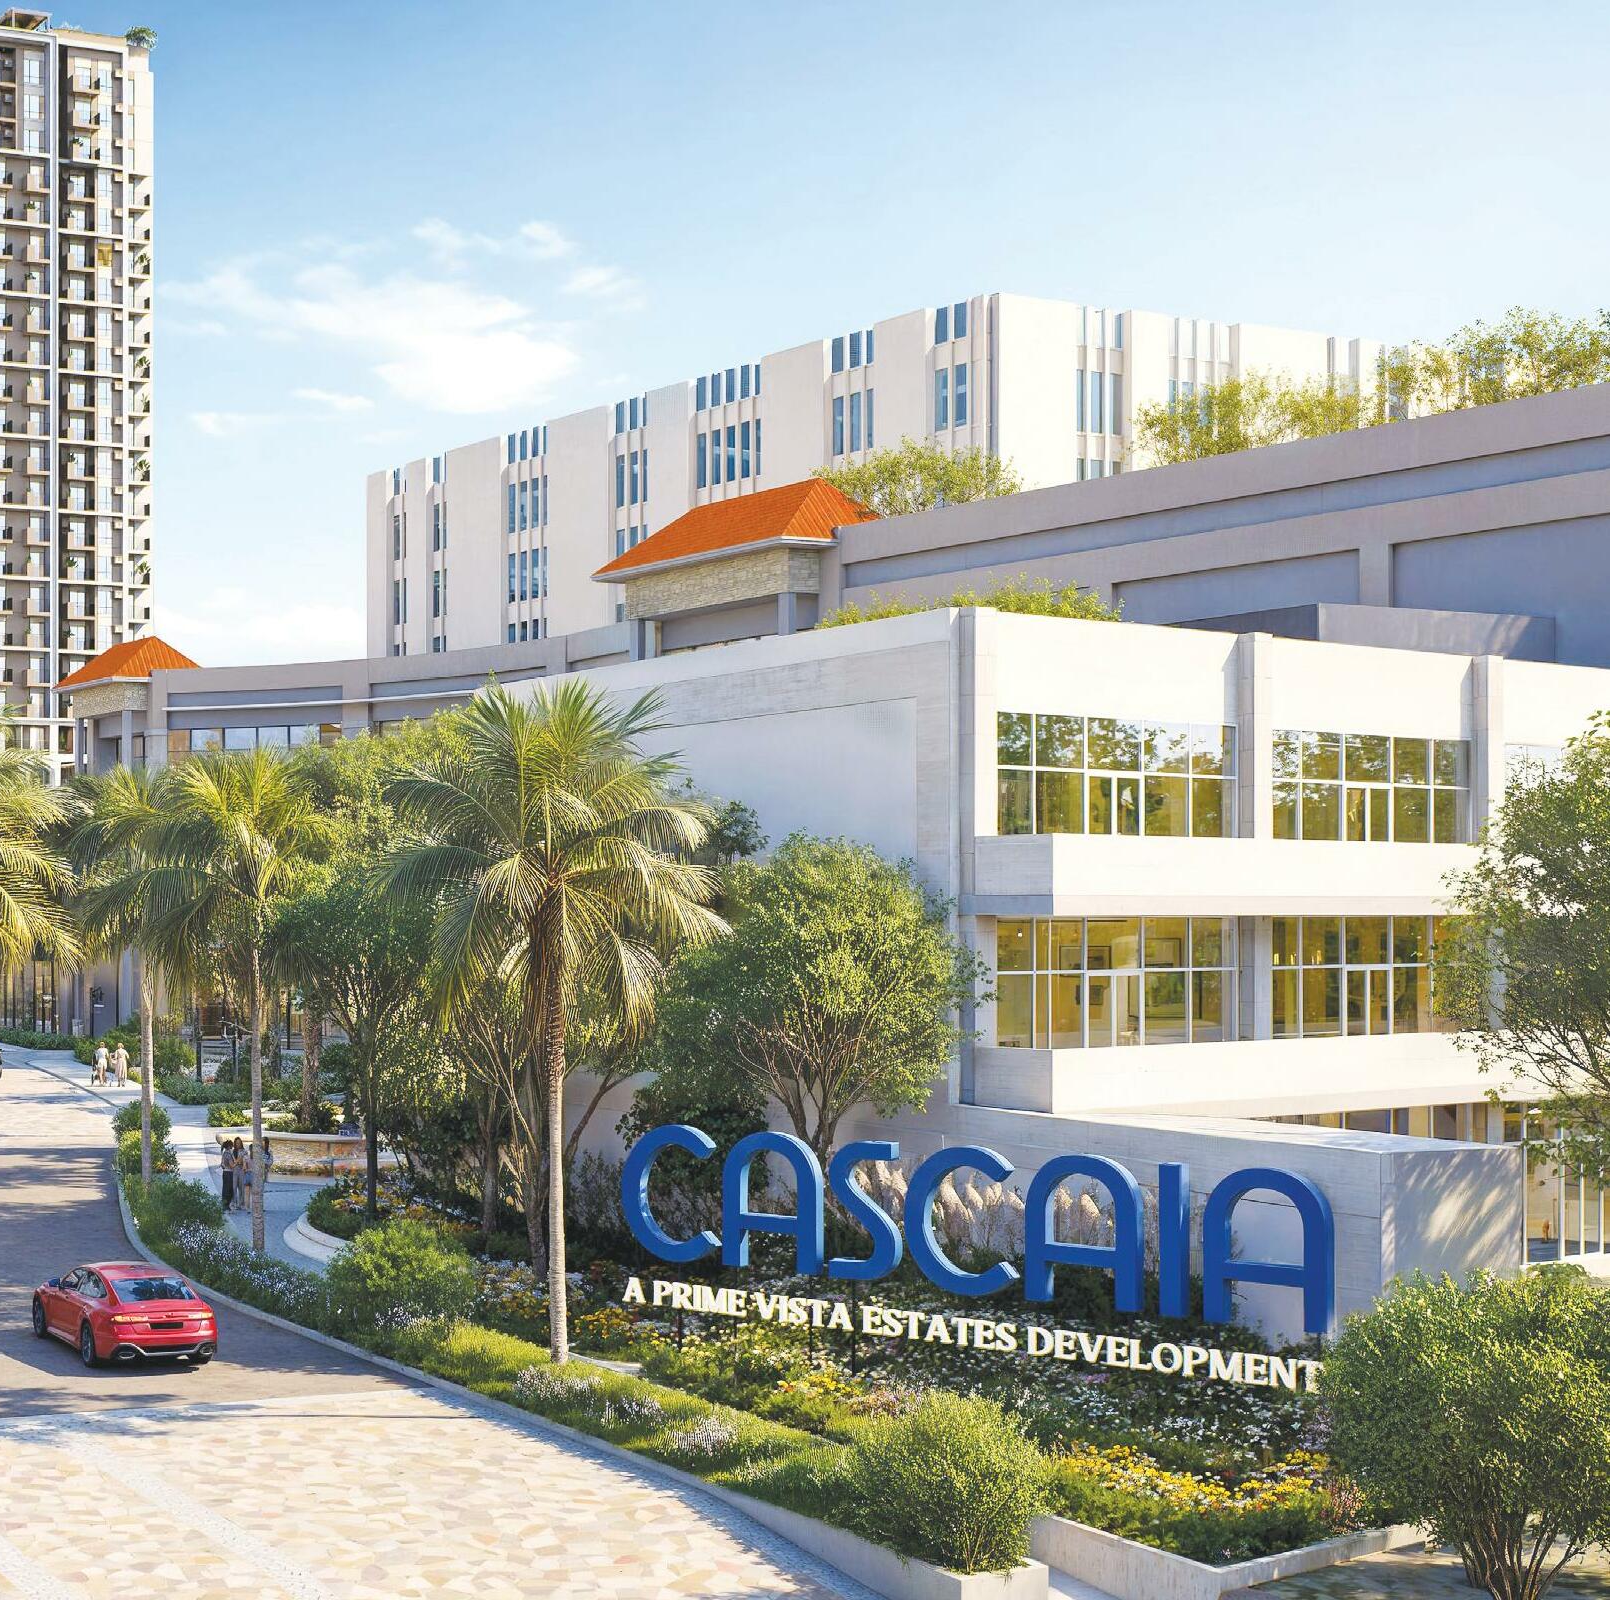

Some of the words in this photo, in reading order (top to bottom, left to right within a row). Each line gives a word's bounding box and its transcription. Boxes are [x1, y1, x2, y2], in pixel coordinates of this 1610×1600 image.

[621, 1124, 1335, 1333] CASCAIA
[621, 1276, 647, 1305] A
[652, 1279, 748, 1319] PRIME
[754, 1291, 855, 1332] VISTA
[861, 1304, 1018, 1352] ESTATES
[1027, 1326, 1324, 1394] DEVELOPMENT
